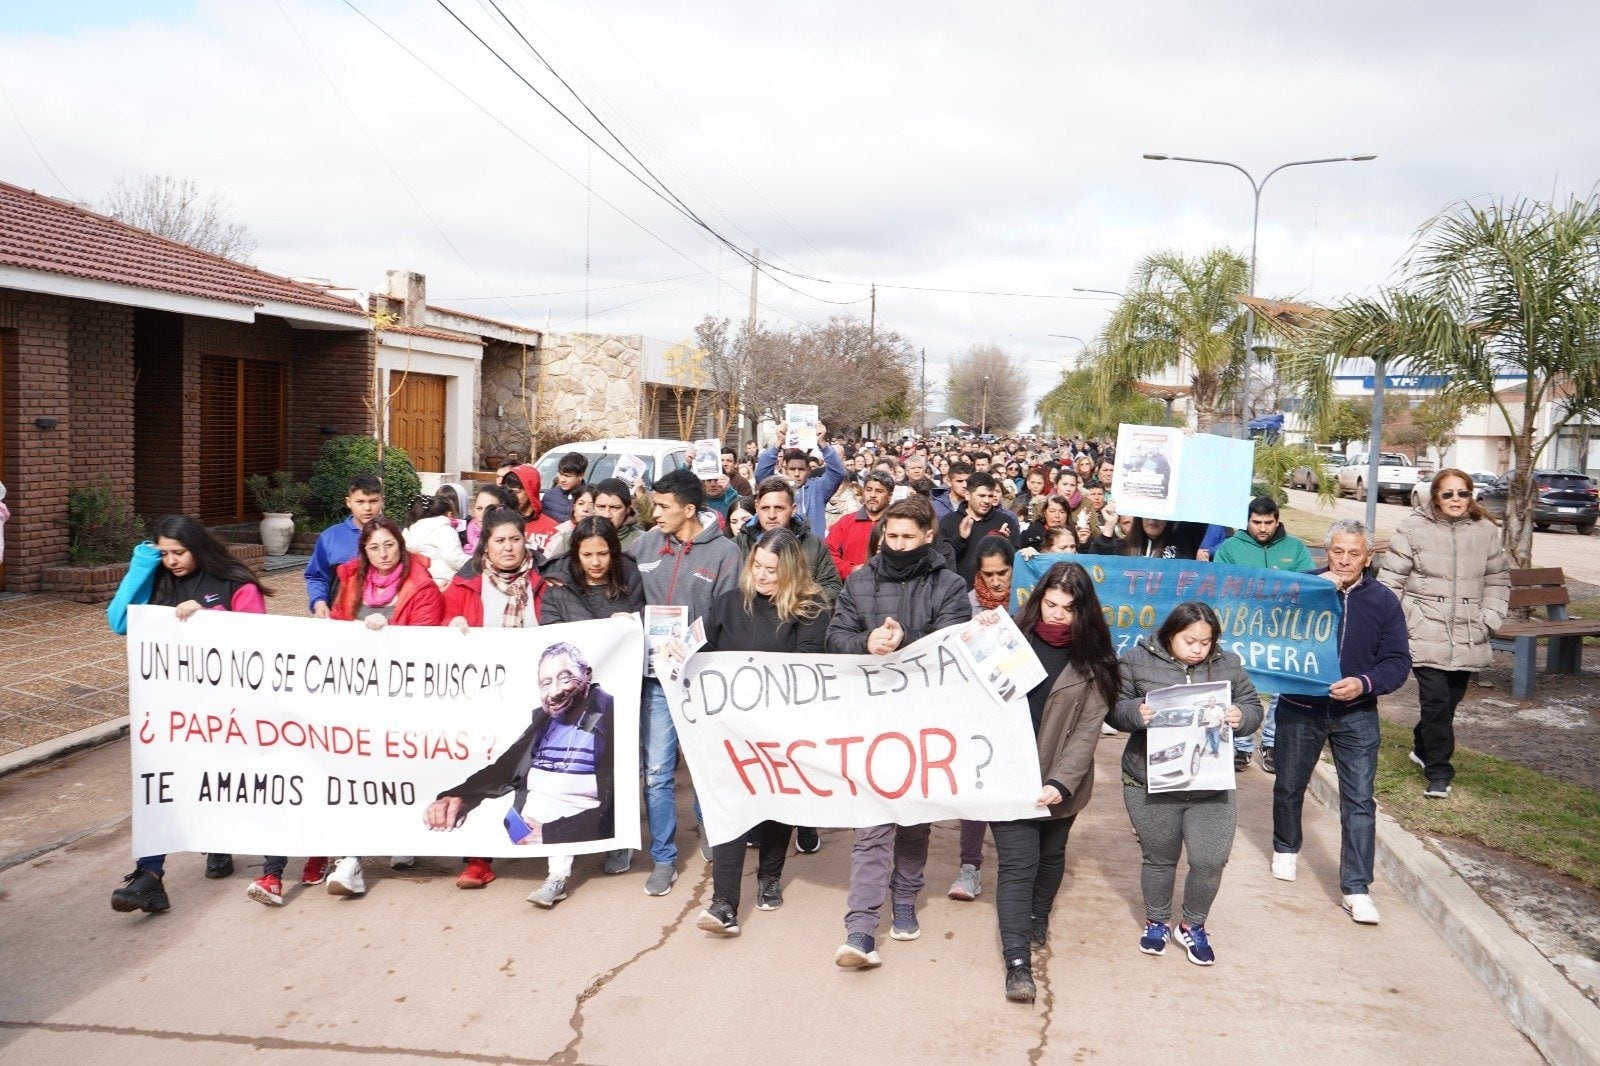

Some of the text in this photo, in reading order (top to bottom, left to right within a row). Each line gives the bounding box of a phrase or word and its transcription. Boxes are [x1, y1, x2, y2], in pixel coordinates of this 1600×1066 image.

[1390, 377, 1419, 387] YPF
[1123, 570, 1163, 595] TU
[1176, 571, 1301, 603] FAMILIA
[1101, 603, 1332, 643] ODO NBASILIO
[140, 641, 507, 700] UN HIJO NO SE CANSA DE BUSCAR
[858, 633, 969, 697] ESTÁ
[1216, 639, 1319, 675] SPERA
[170, 708, 248, 745] PAPÁ
[256, 719, 371, 757] DONDE
[723, 728, 958, 799] HECTOR
[141, 771, 416, 805] TE AMAMOS DIONO
